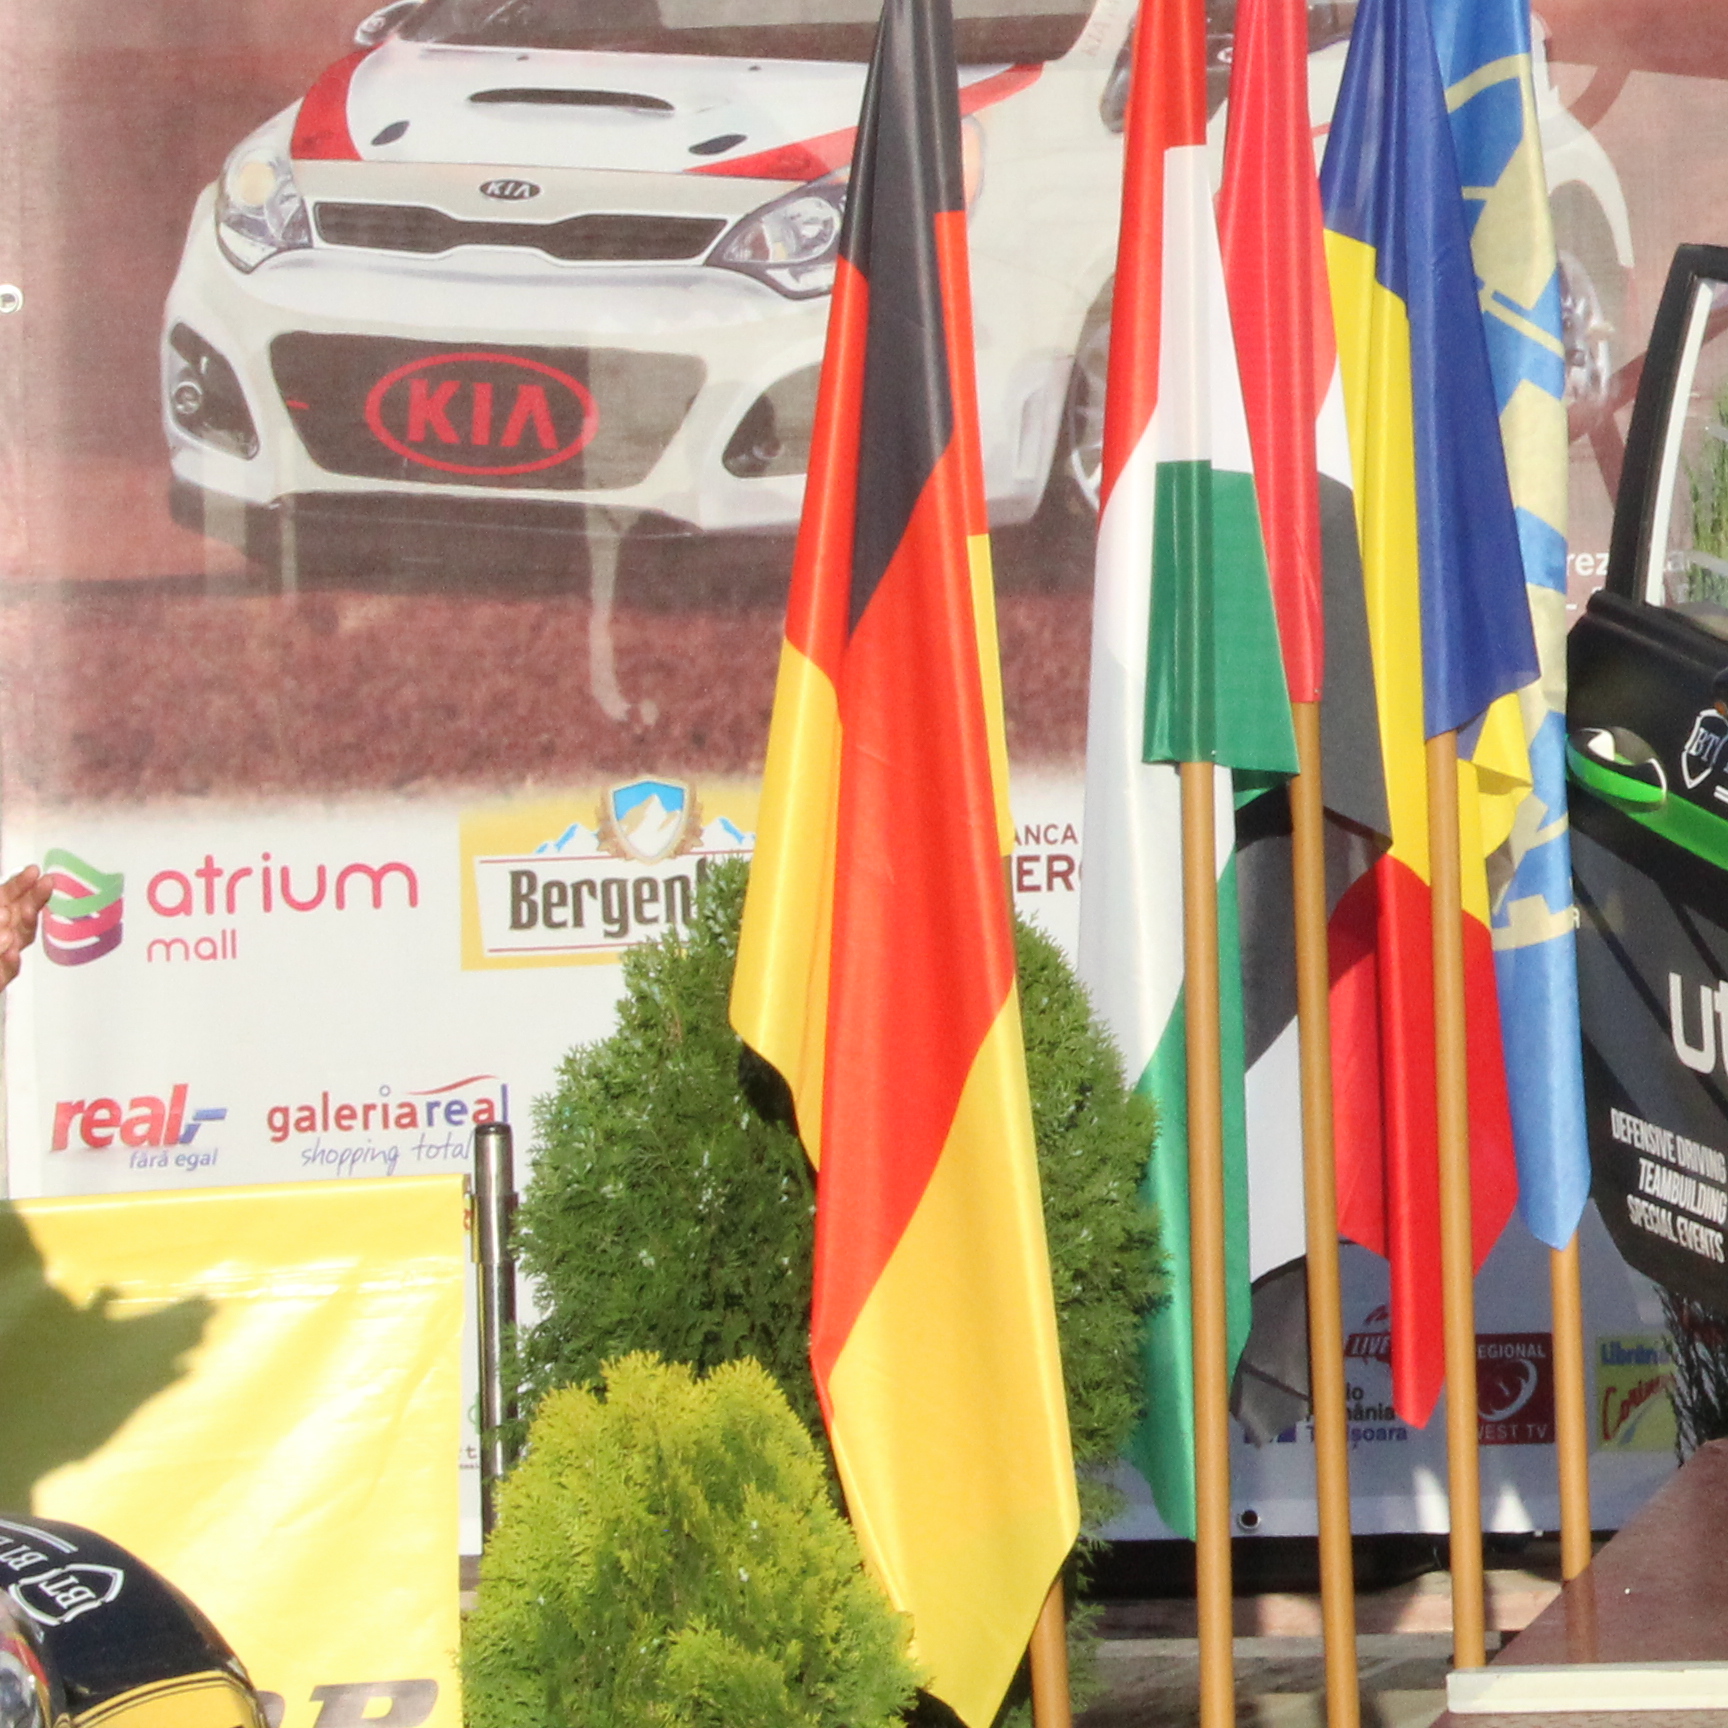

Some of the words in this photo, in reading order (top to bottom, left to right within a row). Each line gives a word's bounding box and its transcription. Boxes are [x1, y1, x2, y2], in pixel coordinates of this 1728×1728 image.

[486, 179, 533, 200] KIA
[403, 377, 560, 451] KIA
[146, 850, 419, 920] atrium
[146, 928, 238, 964] mall
[129, 1150, 169, 1170] fără
[174, 1148, 219, 1172] egal
[301, 1136, 400, 1176] shopping
[411, 1130, 475, 1162] total
[1610, 1106, 1677, 1164] DEFENSIVE
[1676, 1133, 1727, 1185] DRIVING
[1638, 1157, 1728, 1225] TEAMBUILDING
[1626, 1193, 1678, 1244] SPECIAL
[1676, 1216, 1726, 1264] EVENTS
[1526, 1423, 1548, 1439] TV
